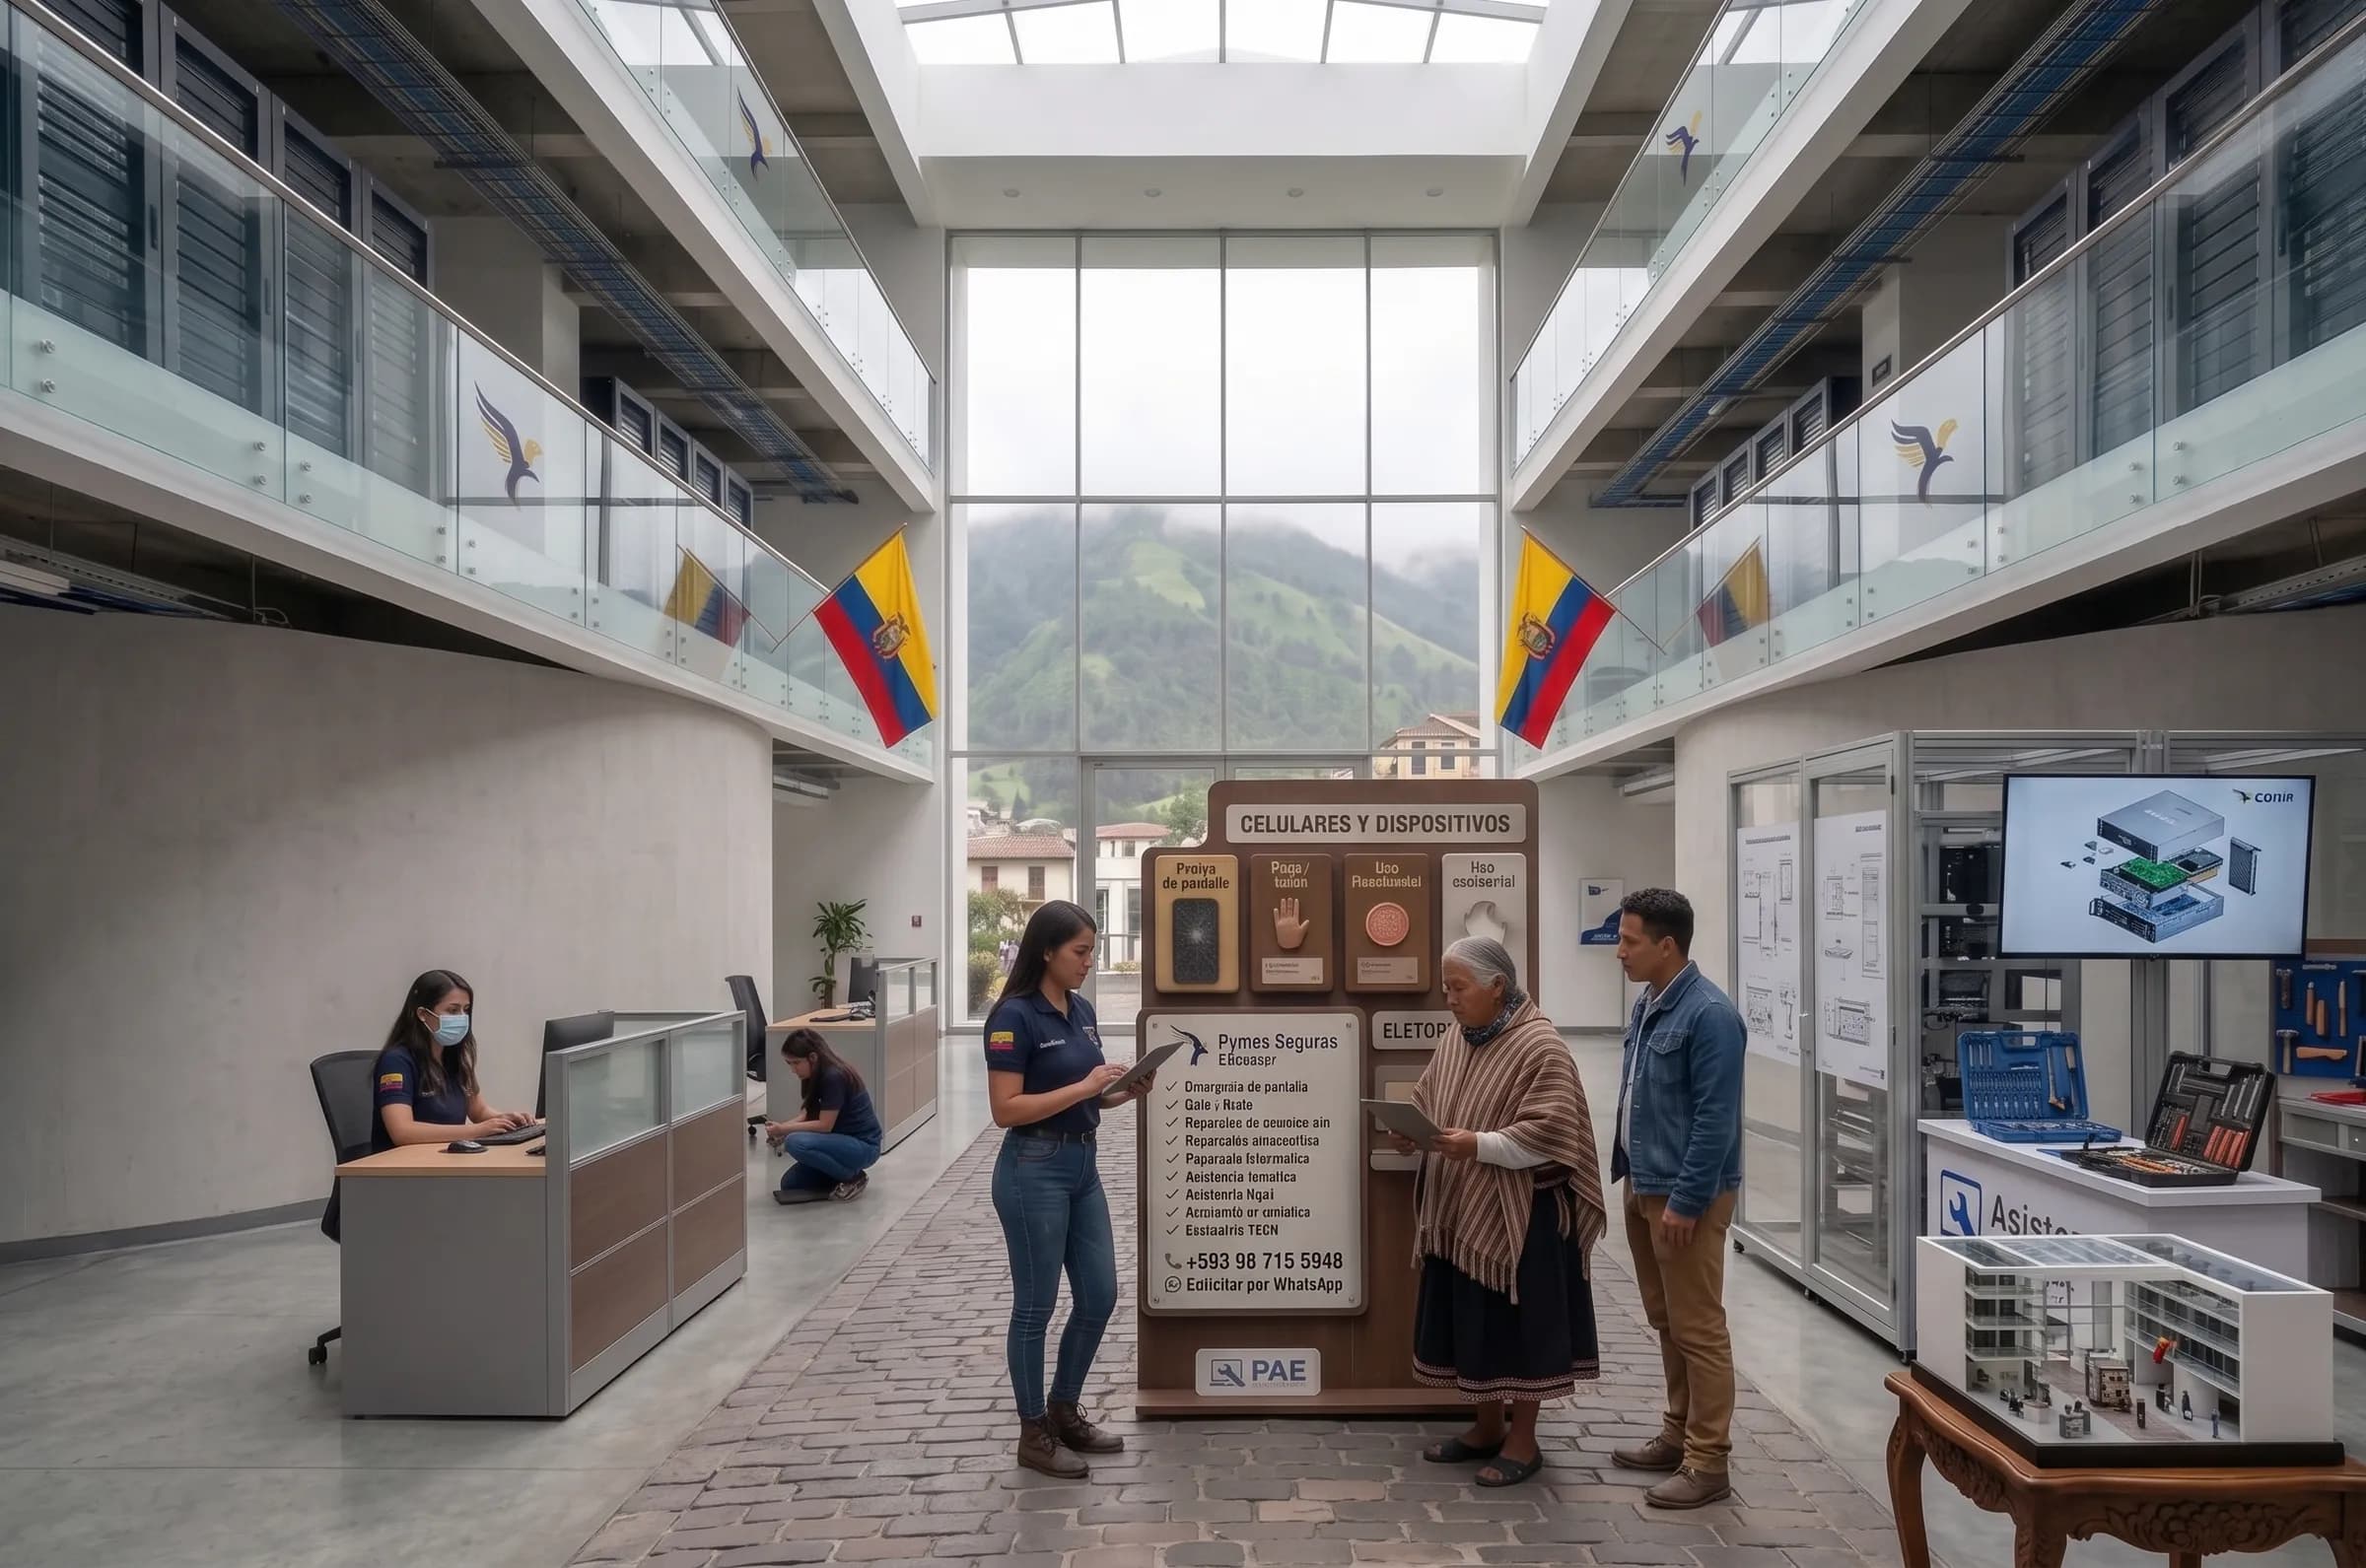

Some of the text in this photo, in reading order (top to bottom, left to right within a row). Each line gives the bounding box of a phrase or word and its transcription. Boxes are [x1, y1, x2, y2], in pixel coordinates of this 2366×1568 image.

[1240, 814, 1510, 834] CELULARES Y DISPOSITIVOS
[1162, 877, 1177, 889] de
[1383, 1022, 1452, 1039] ELETOP
[1218, 1033, 1339, 1055] Pymes Seguras
[1247, 1080, 1261, 1093] de
[1185, 1099, 1212, 1111] Gale
[1246, 1117, 1260, 1128] de
[1312, 1117, 1331, 1128] ain
[1247, 1224, 1279, 1237] TECN
[1186, 1252, 1343, 1270] +593 98 715 5948
[1247, 1280, 1270, 1294] por
[1274, 1277, 1343, 1294] WhatsApp
[1252, 1360, 1306, 1382] PAE
